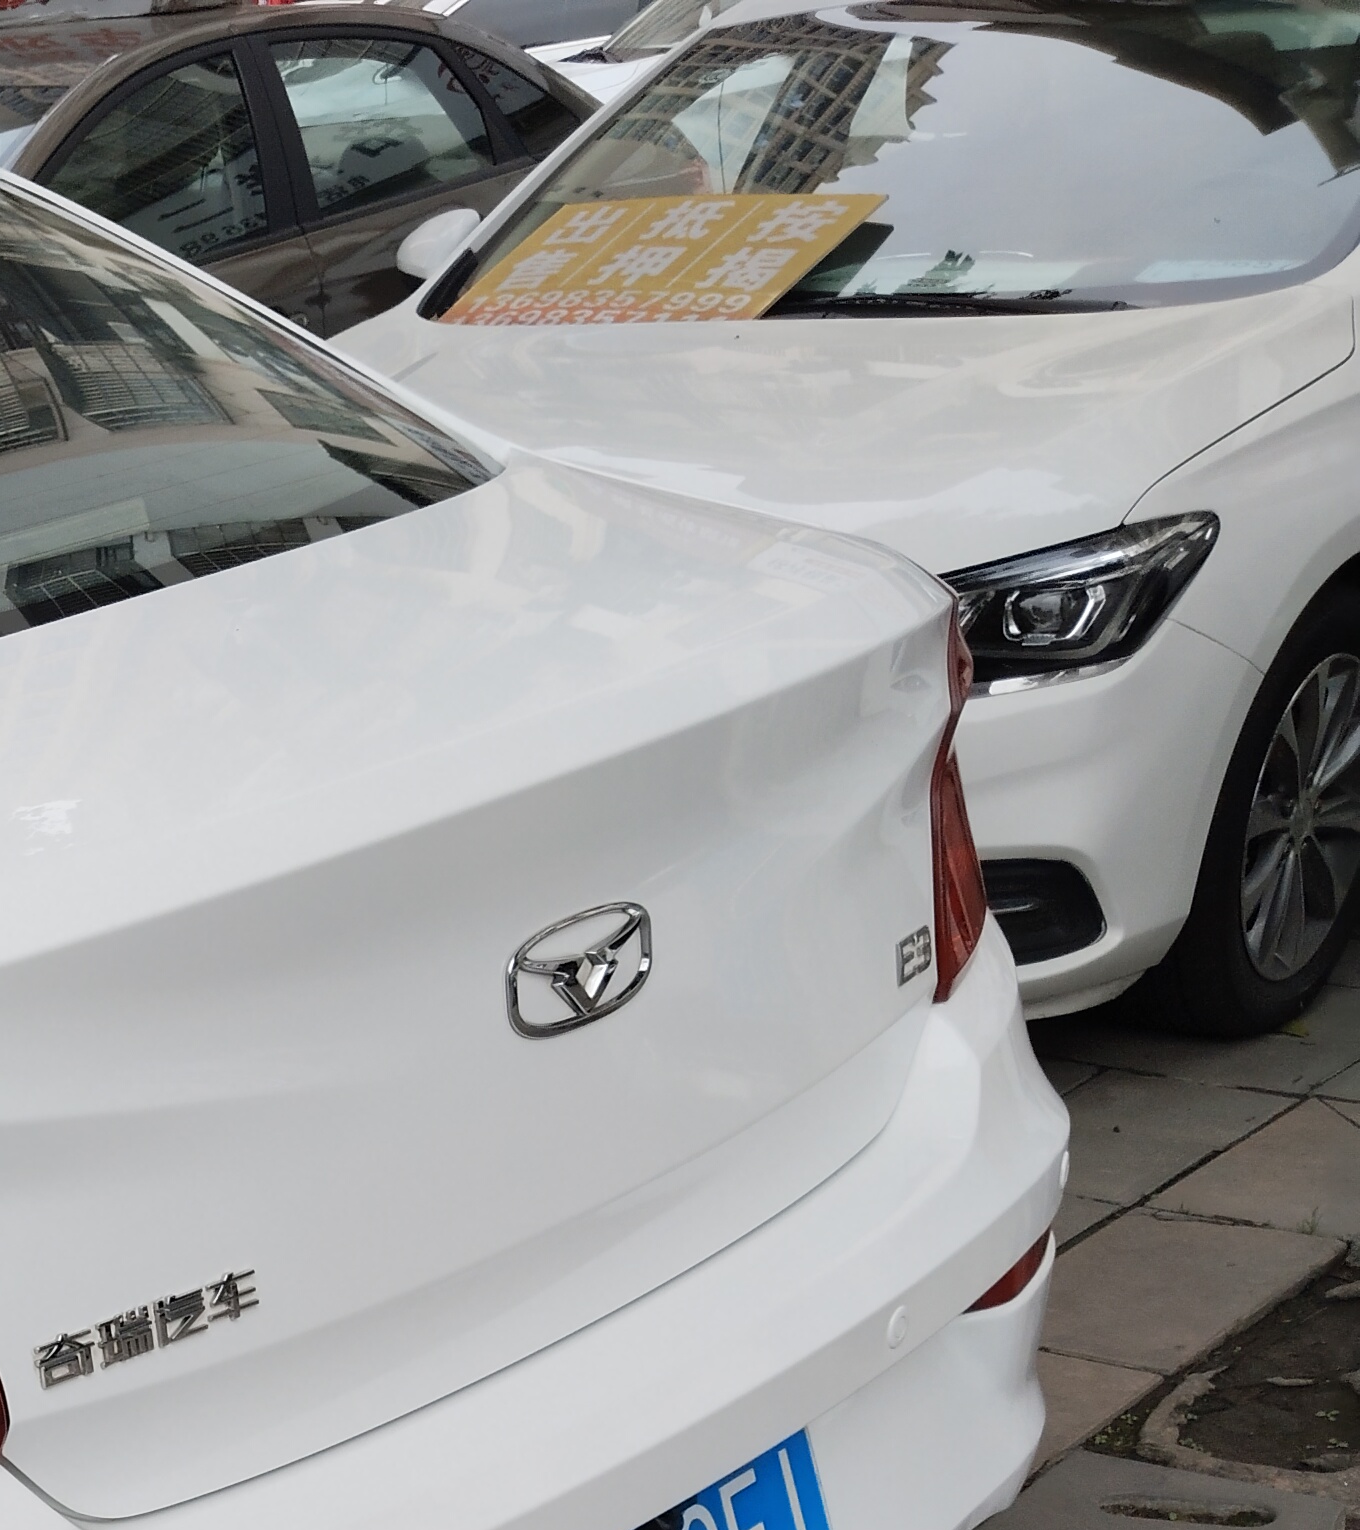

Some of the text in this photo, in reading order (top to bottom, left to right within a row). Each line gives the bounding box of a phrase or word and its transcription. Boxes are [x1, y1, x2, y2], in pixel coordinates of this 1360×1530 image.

[494, 205, 628, 291] 出售
[588, 199, 735, 287] 抵押
[695, 199, 849, 292] 按揭
[467, 288, 753, 314] 13698357999
[34, 1268, 261, 1391] 奇瑞汽车
